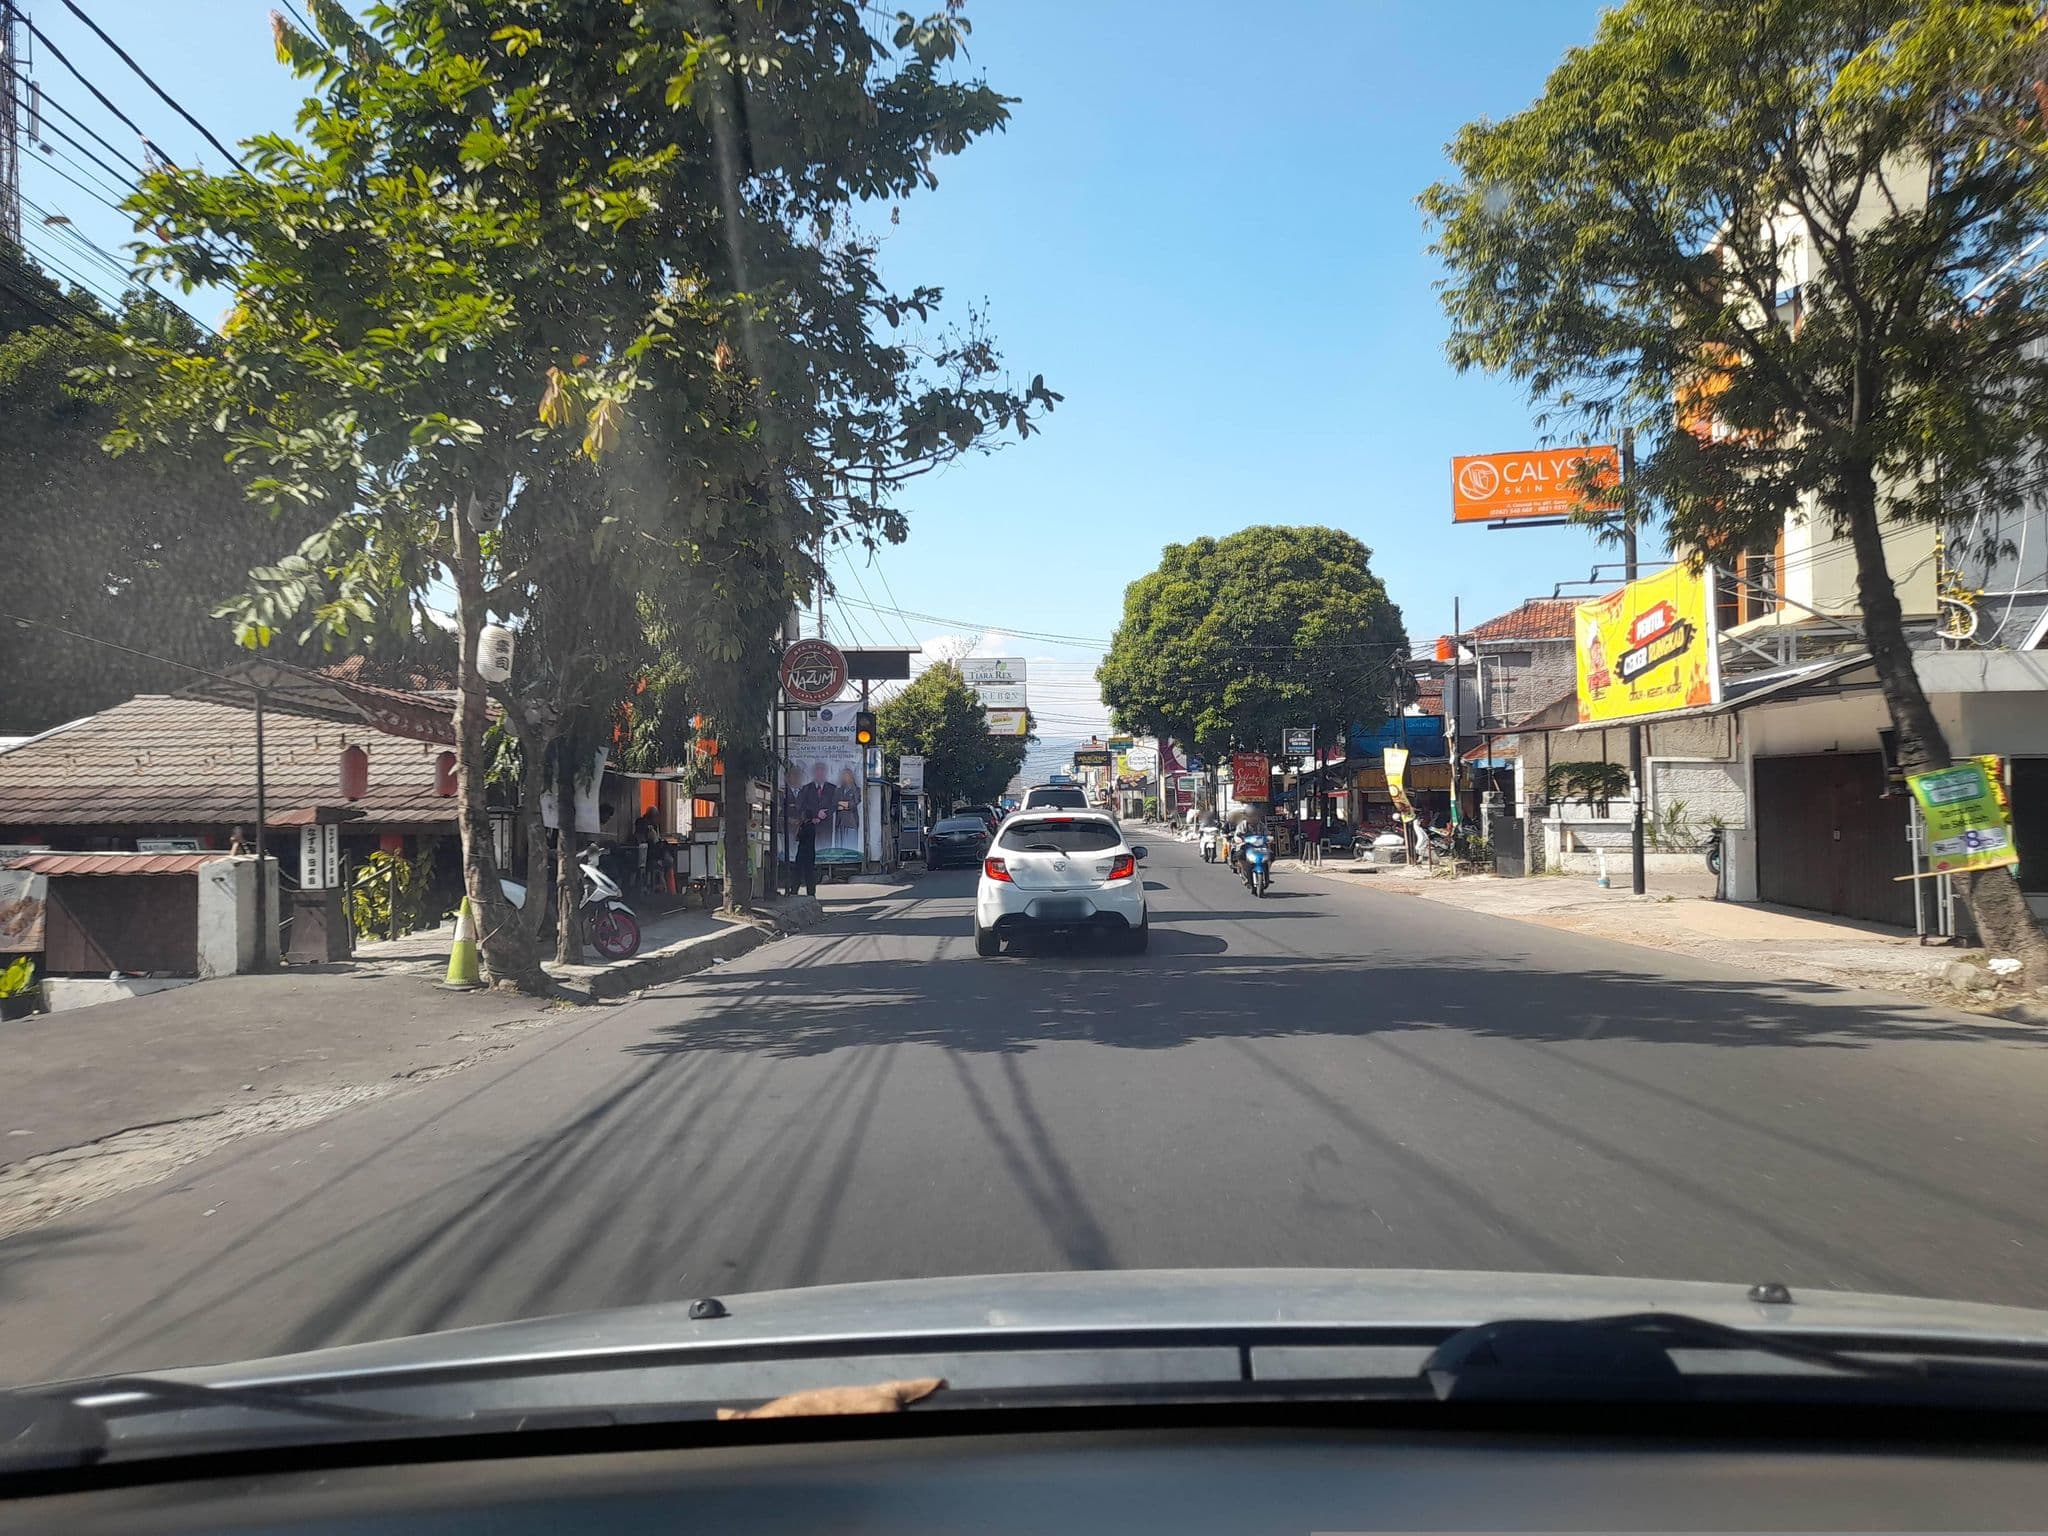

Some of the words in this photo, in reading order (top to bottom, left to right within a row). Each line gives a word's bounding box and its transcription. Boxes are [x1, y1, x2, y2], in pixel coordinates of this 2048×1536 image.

[1503, 456, 1613, 483] CALYS
[1504, 485, 1543, 496] SKIN
[788, 670, 837, 689] NAZUMI
